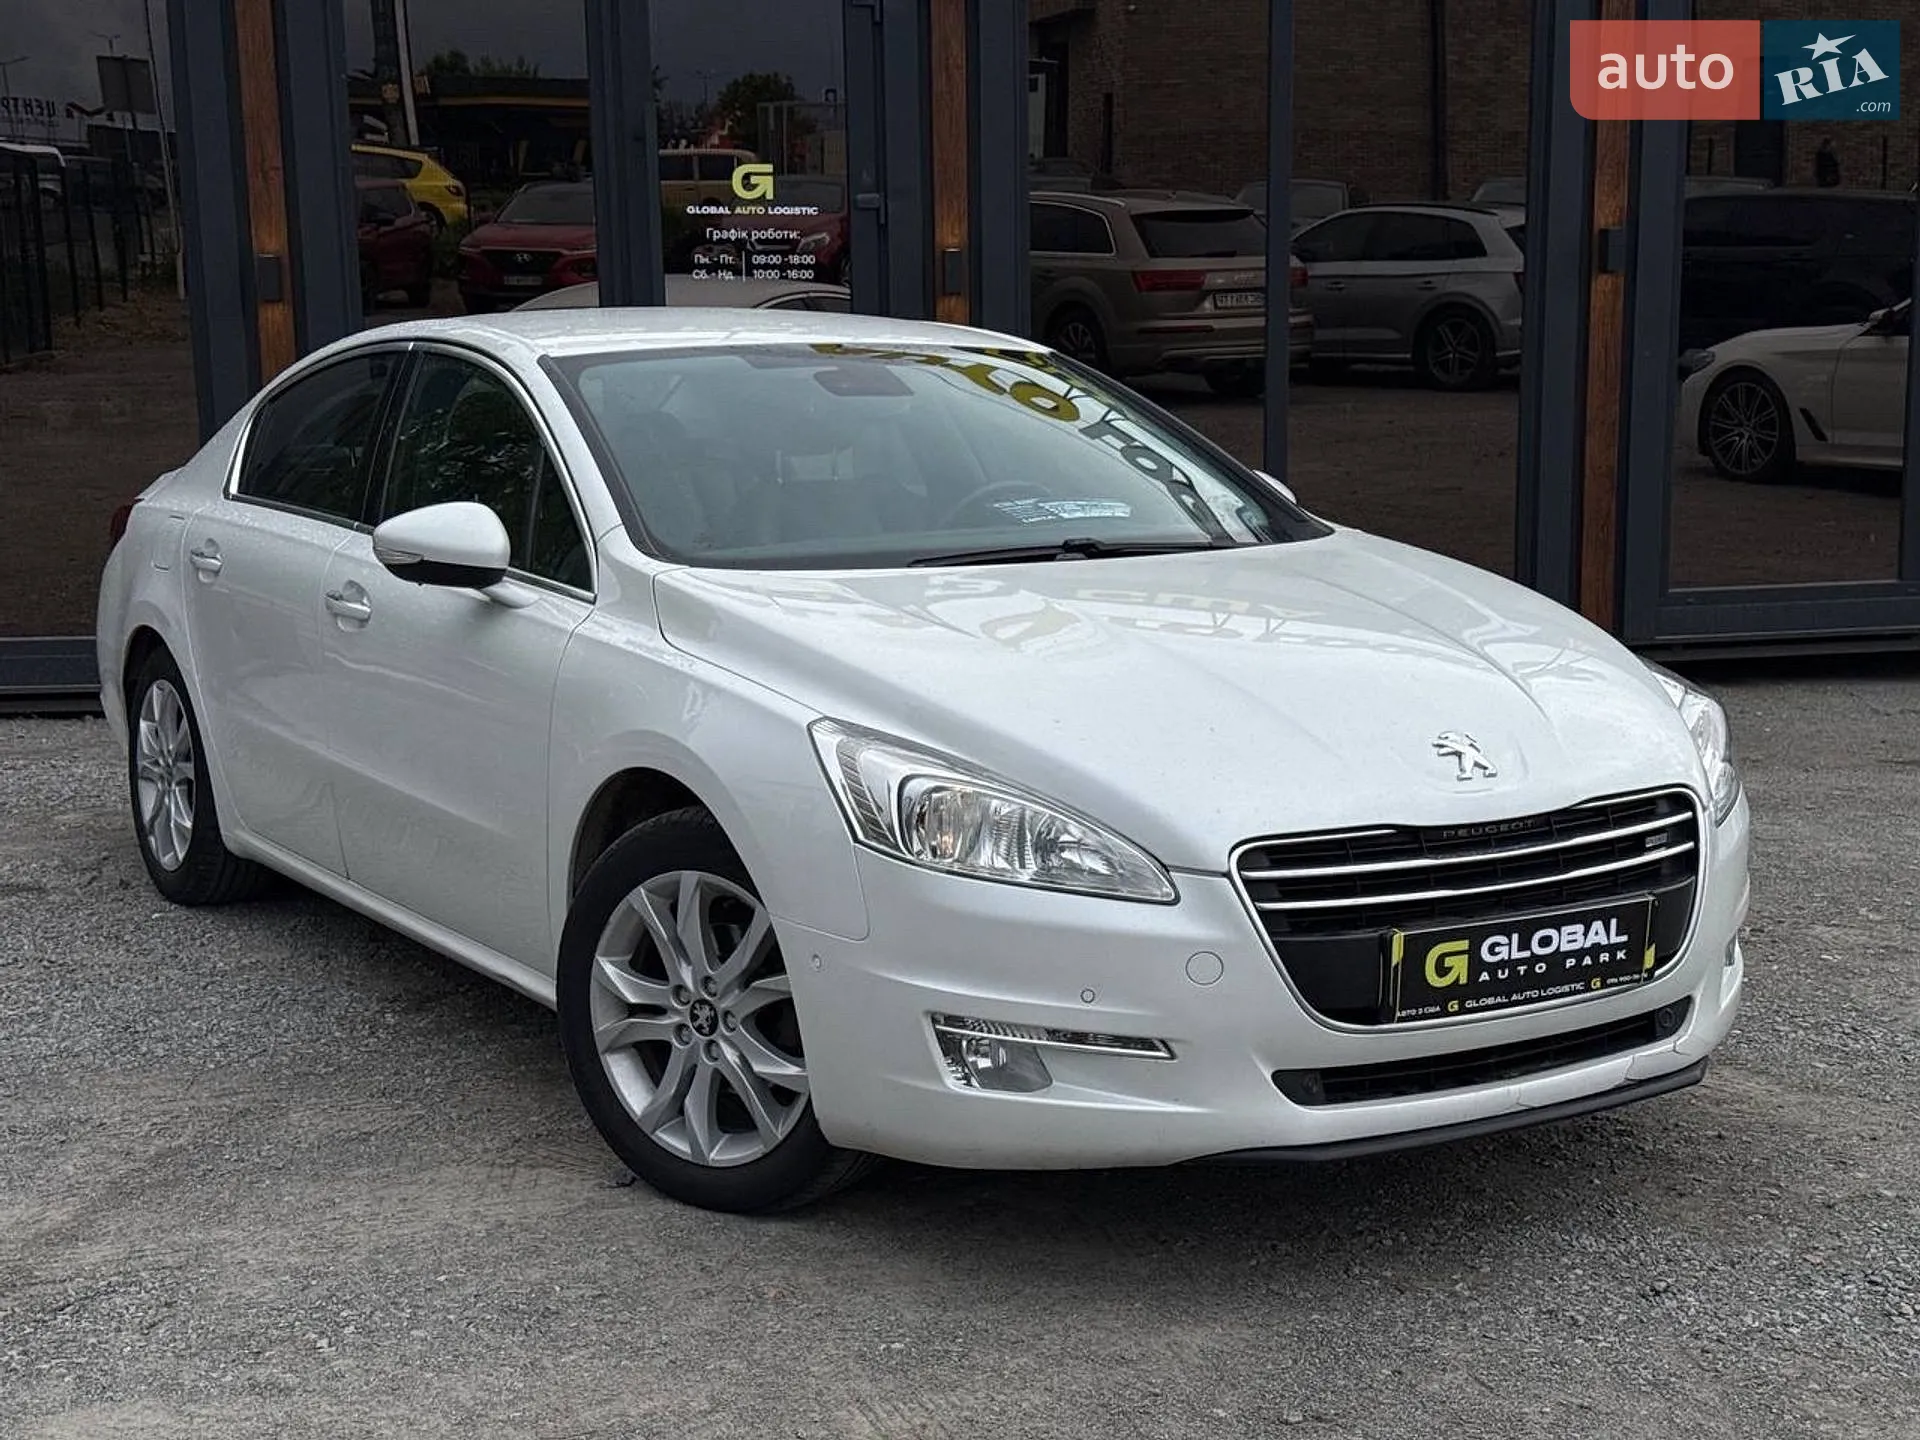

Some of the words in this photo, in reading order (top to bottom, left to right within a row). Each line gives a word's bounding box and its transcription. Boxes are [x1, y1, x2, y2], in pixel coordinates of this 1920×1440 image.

[687, 205, 731, 214] GLOBAL
[734, 206, 765, 214] AUTO
[768, 206, 819, 215] LOGISTIC
[706, 228, 749, 241] Графік
[751, 228, 801, 240] роботи:
[752, 255, 782, 264] 09:00
[753, 269, 780, 279] 10:00
[1442, 818, 1536, 840] PEUGEOT
[1480, 918, 1629, 963] GLOBAL
[1478, 962, 1547, 982] AUTO
[1565, 949, 1627, 969] PARK
[1465, 995, 1509, 1008] GLOBAL
[1511, 990, 1539, 1001] AUTO
[1540, 982, 1585, 996] LOGISTIC
